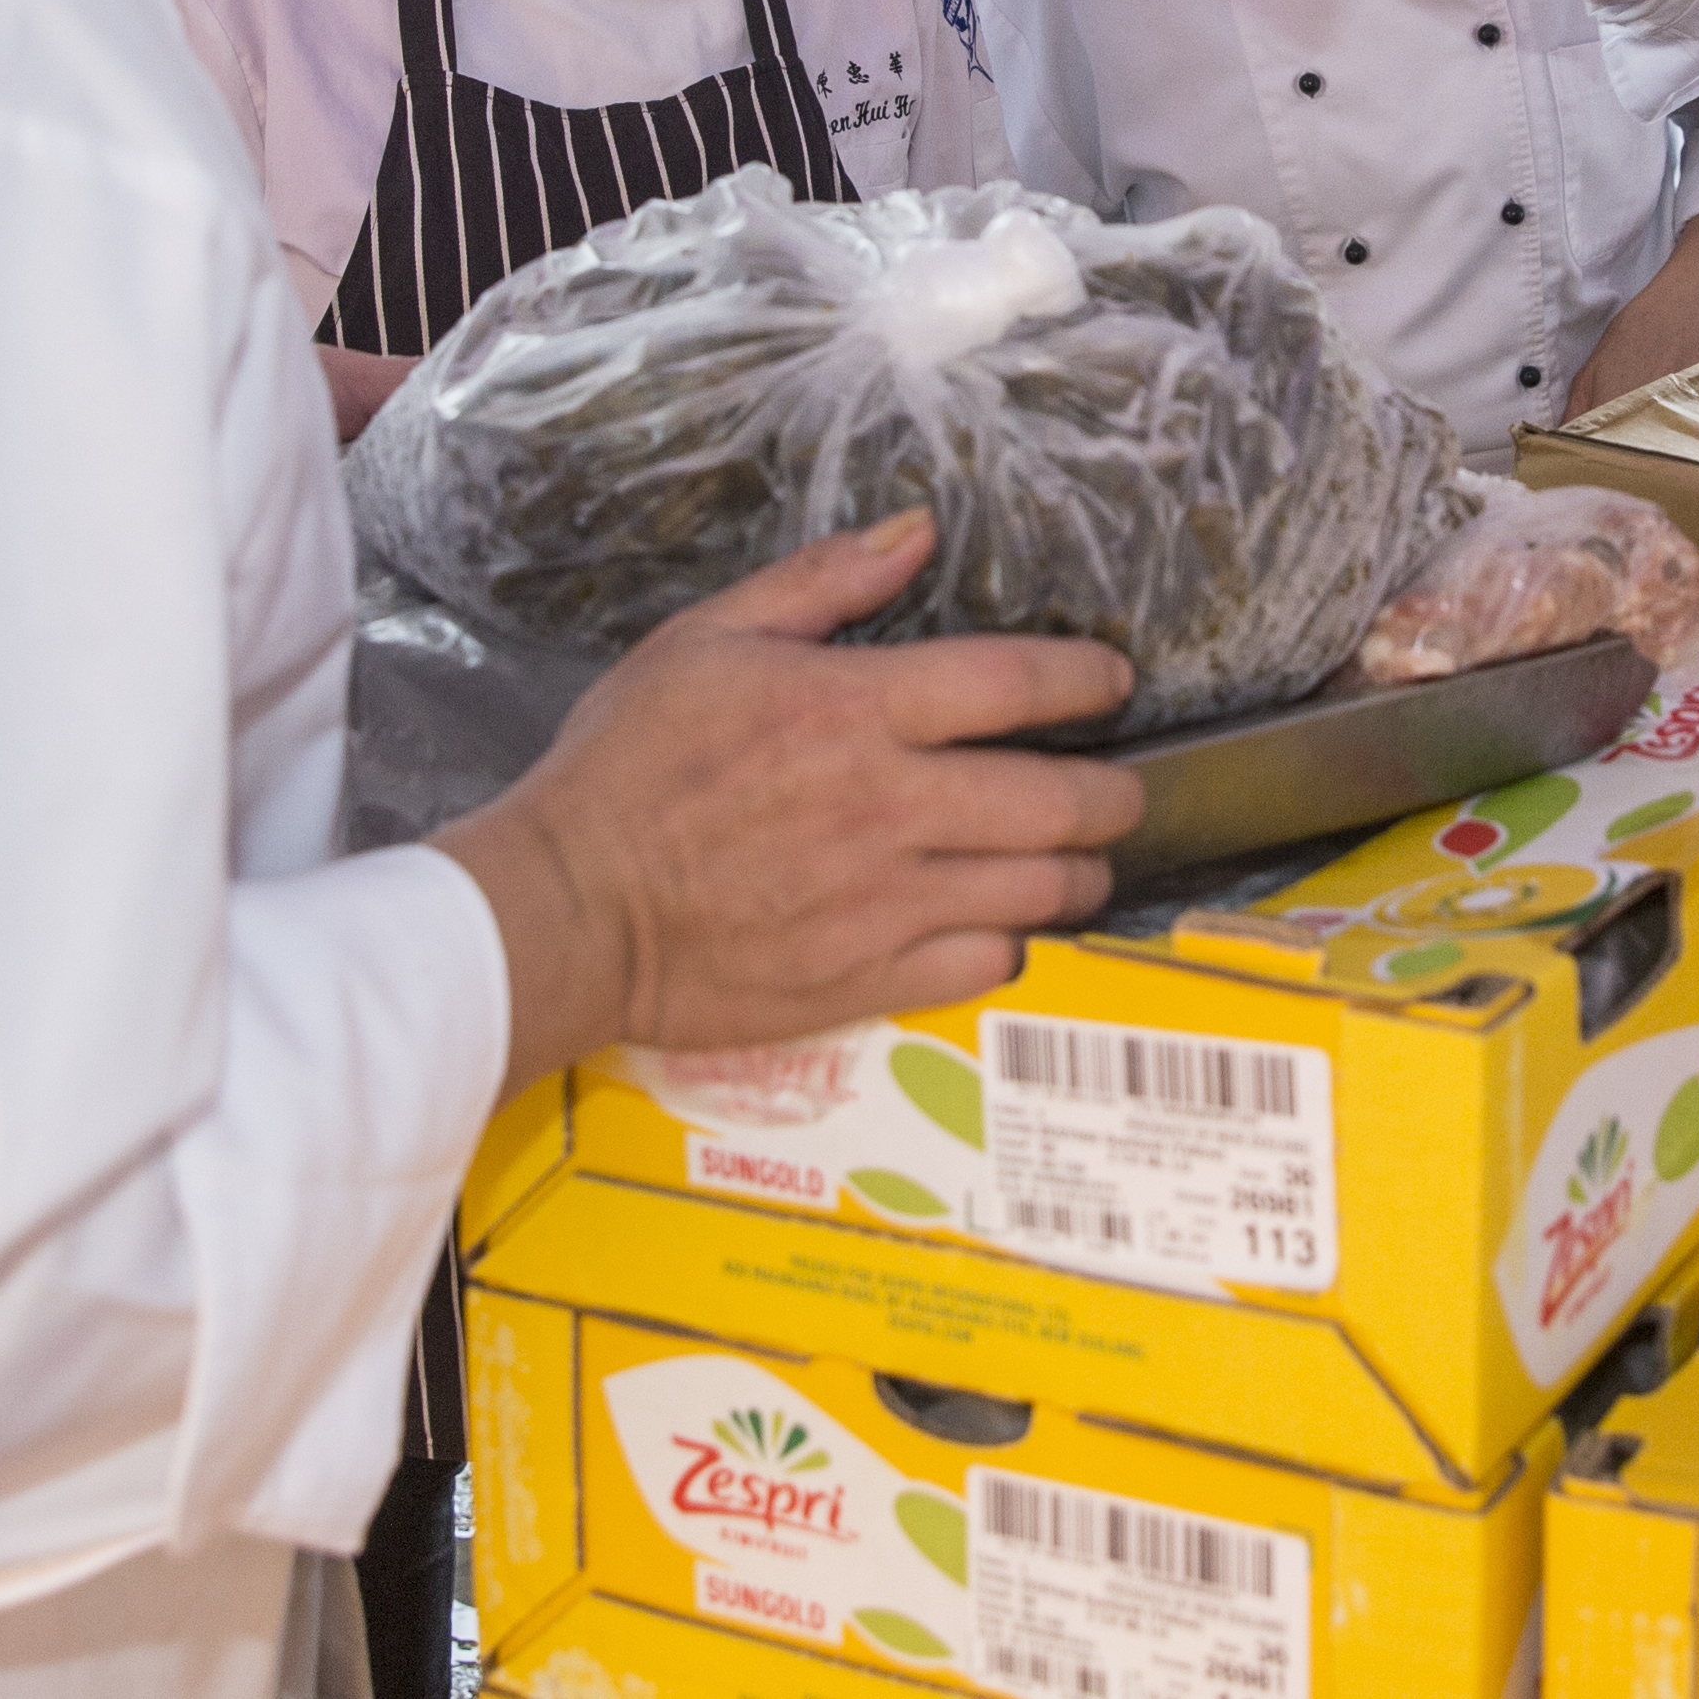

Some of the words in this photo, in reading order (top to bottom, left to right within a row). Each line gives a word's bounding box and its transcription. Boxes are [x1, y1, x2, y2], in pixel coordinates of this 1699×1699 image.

[828, 113, 853, 135] en
[853, 99, 891, 129] Hui
[701, 1145, 825, 1197] SUNGOLD
[1247, 1224, 1317, 1267] 113
[669, 1431, 859, 1544] Zespri
[706, 1574, 827, 1632] SUNGOLD
